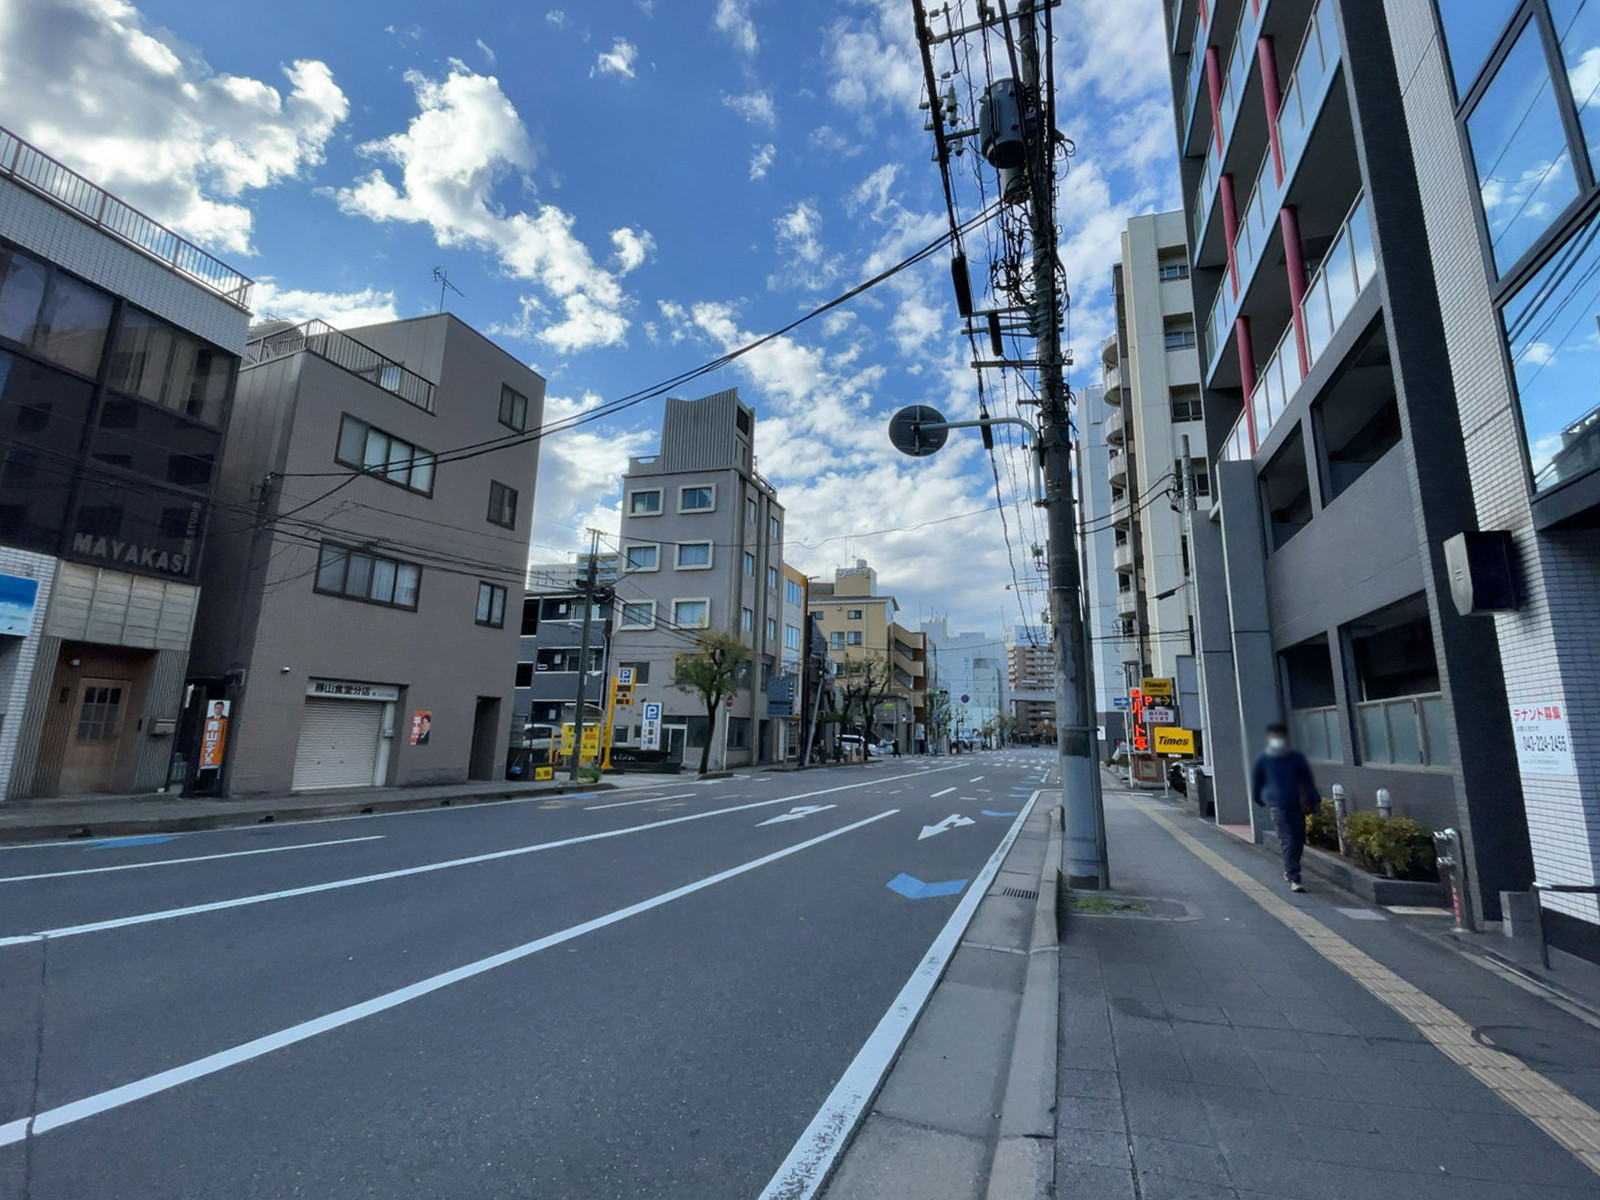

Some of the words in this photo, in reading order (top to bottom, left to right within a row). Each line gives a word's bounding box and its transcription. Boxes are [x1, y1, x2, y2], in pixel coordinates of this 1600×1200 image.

[73, 532, 191, 574] MAYAKASI
[315, 682, 371, 697] 勝山食堂分店
[1514, 706, 1561, 721] テナント募集
[1159, 736, 1189, 745] Times
